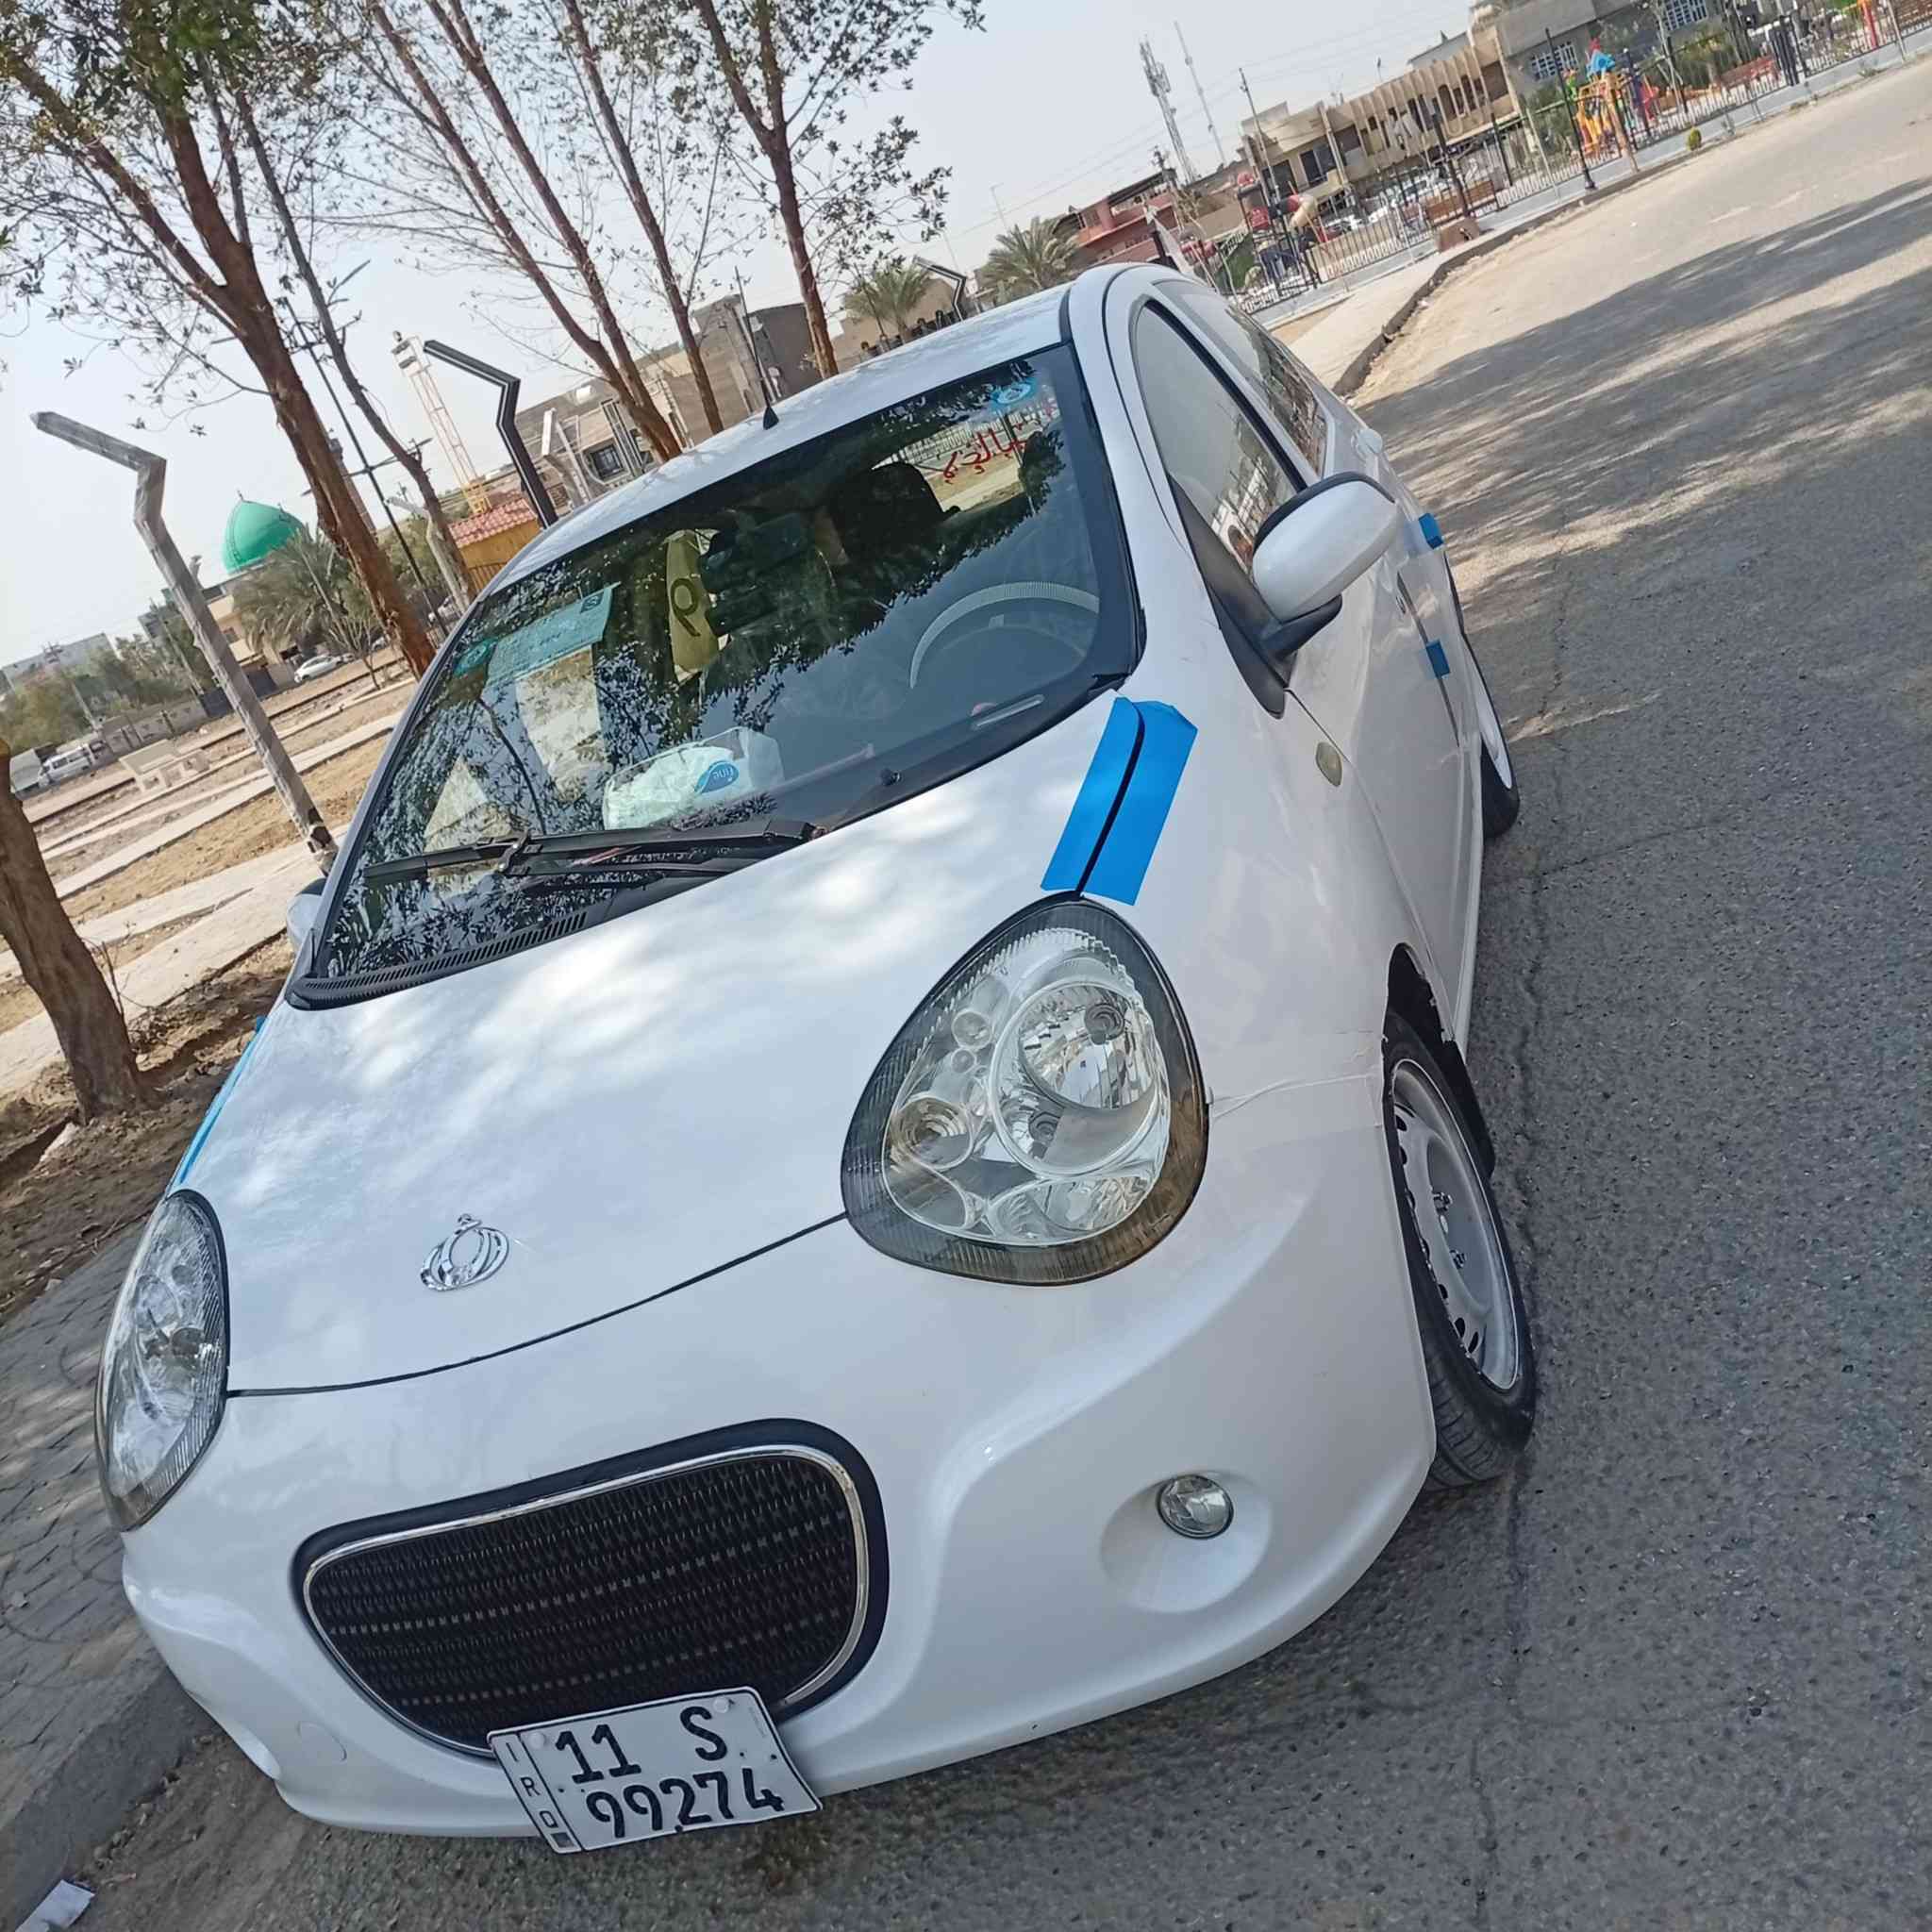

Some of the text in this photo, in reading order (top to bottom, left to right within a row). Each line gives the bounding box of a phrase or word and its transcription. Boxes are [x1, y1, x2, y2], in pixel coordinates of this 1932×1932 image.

[555, 1706, 727, 1784] 11 S
[586, 1768, 785, 1839] 99274
